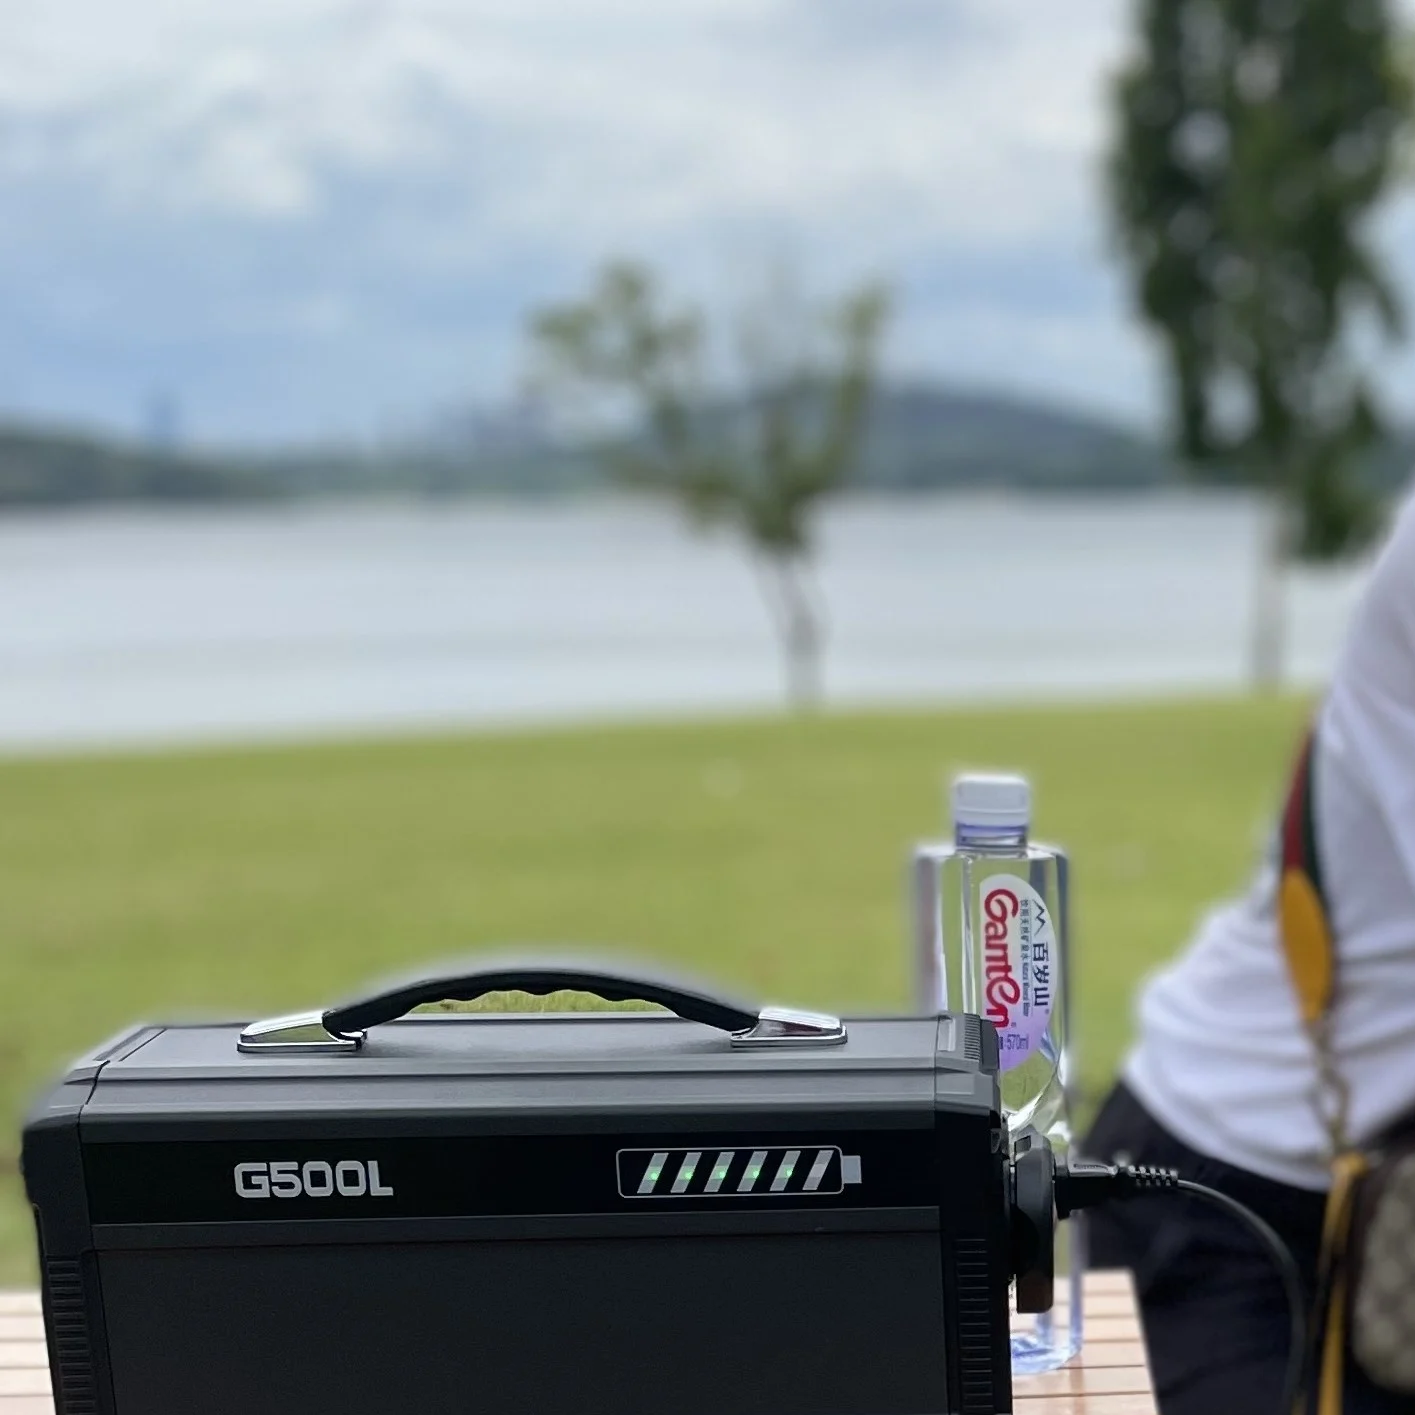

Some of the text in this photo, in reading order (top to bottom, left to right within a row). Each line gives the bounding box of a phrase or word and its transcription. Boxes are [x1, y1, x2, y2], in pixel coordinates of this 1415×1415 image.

[1032, 942, 1050, 1007] 百岁山
[233, 1160, 394, 1199] G500L
